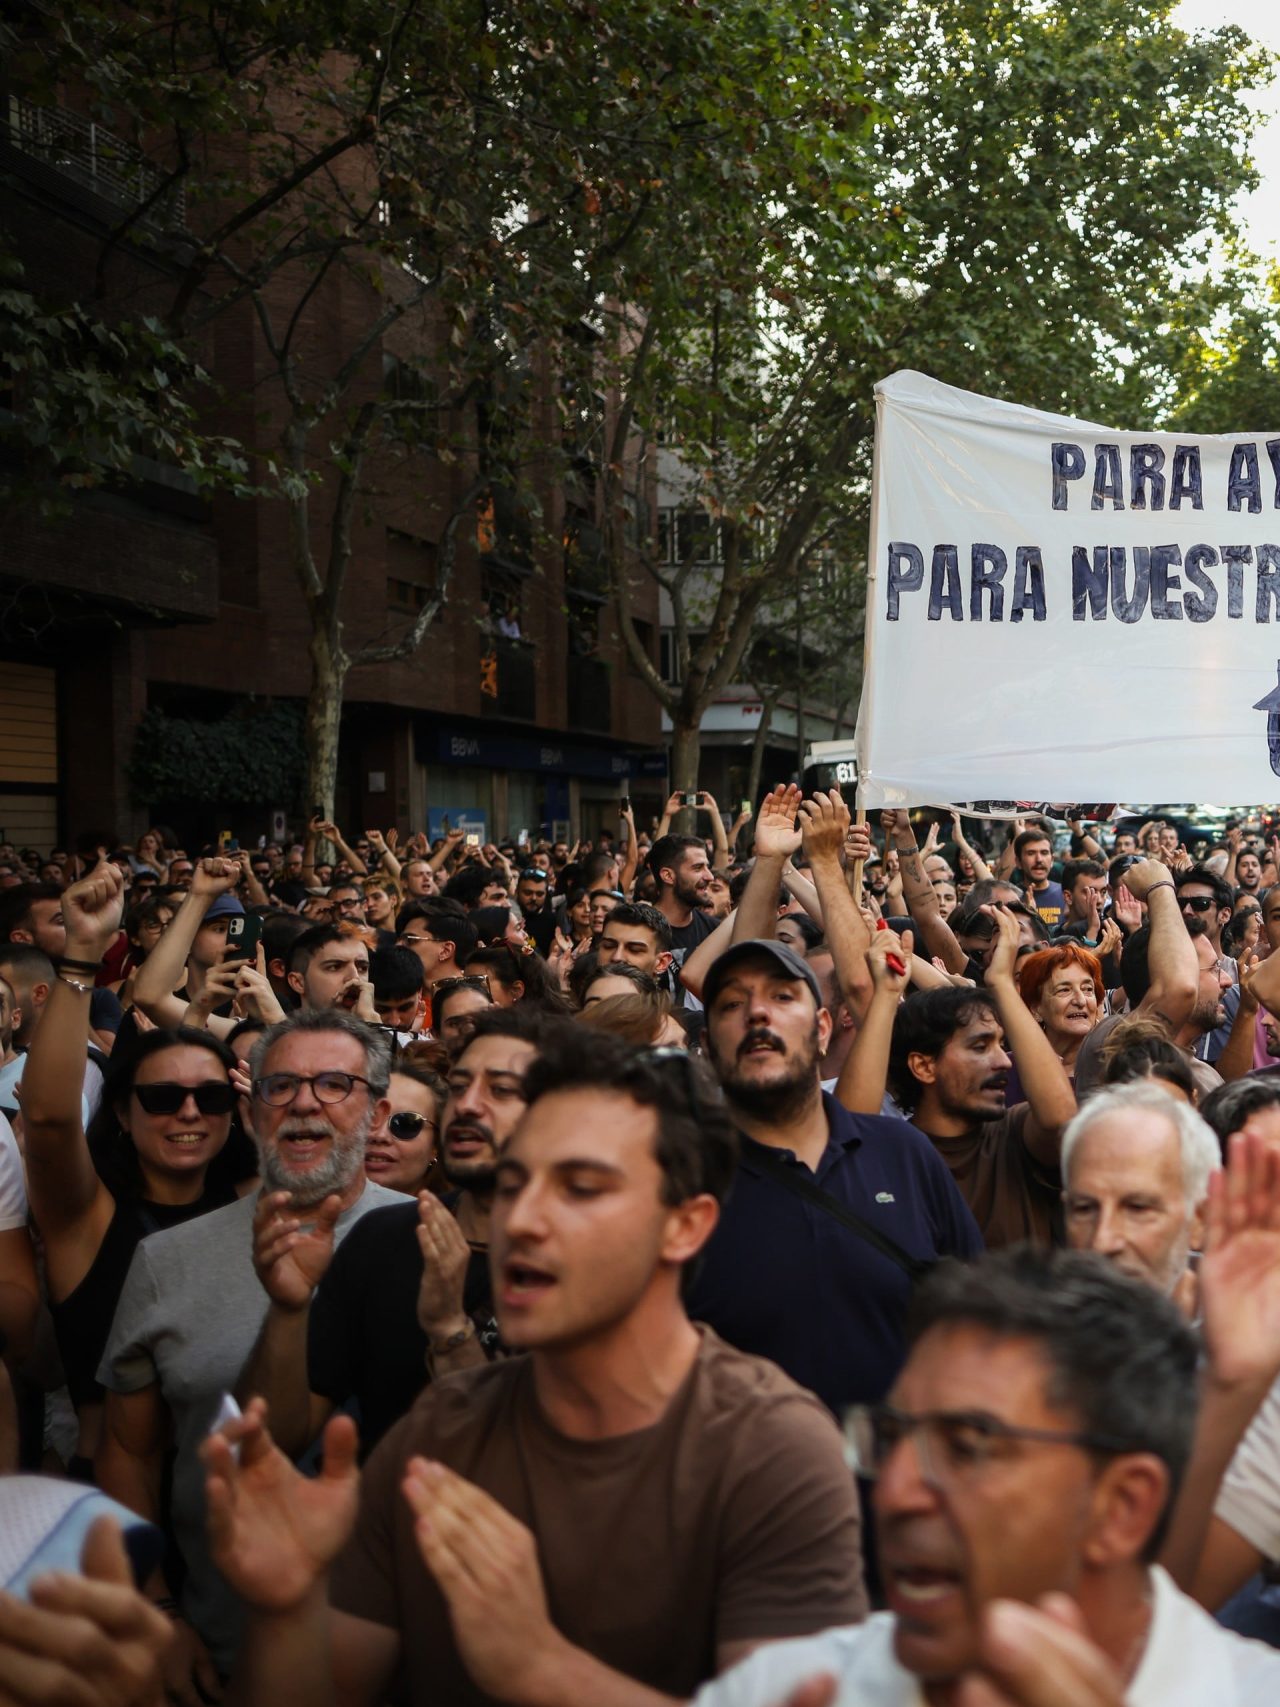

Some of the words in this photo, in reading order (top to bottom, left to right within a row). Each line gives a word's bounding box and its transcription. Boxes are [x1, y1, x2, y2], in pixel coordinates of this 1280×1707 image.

[1051, 442, 1204, 511] PARA
[885, 541, 1048, 623] PARA
[450, 736, 480, 757] BBVA
